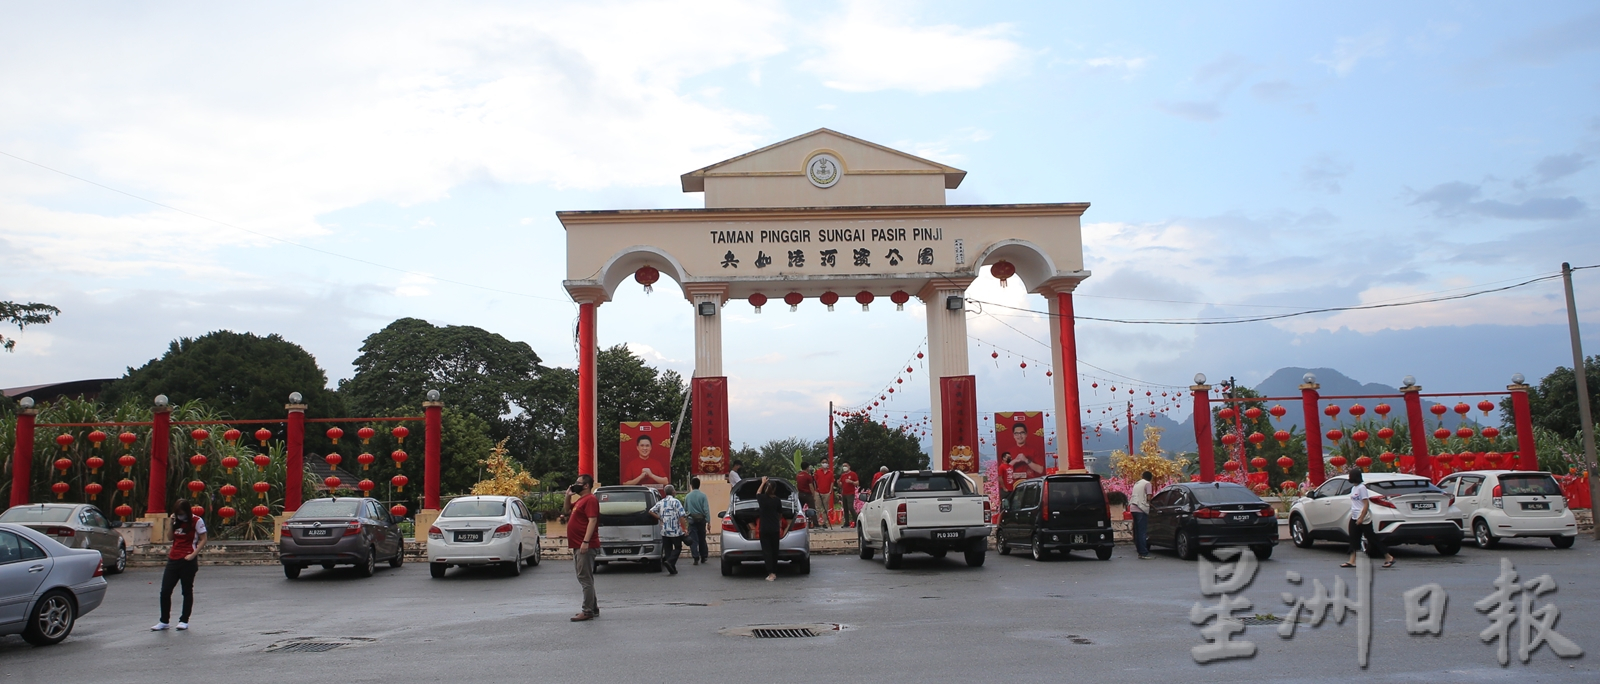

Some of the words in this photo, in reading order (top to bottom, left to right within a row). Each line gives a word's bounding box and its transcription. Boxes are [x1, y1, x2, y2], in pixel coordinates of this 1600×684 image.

[710, 230, 754, 244] TAMAN
[760, 229, 811, 243] PINGGIR
[818, 229, 865, 242] SUNGAI
[871, 228, 907, 242] PASIR
[912, 227, 943, 241] PINJI
